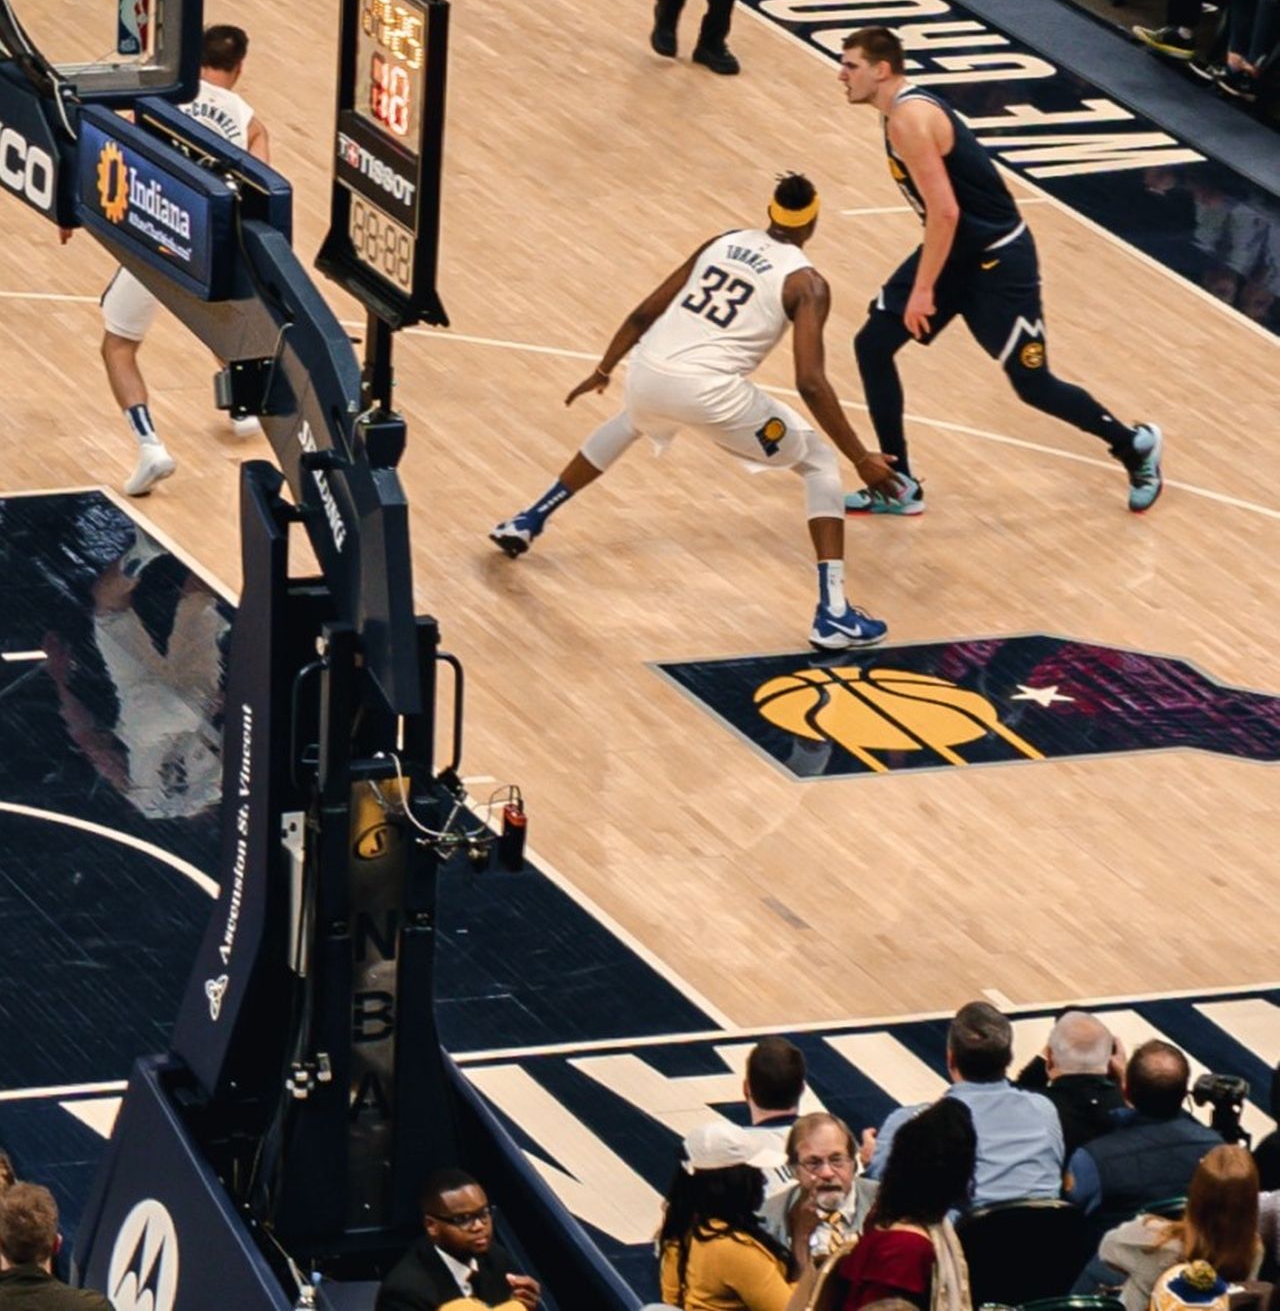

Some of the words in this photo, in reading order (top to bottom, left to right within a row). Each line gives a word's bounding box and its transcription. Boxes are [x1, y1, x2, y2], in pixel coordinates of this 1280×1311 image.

[184, 101, 242, 139] CONNELL
[953, 98, 1208, 180] WE
[129, 167, 191, 240] Indiana
[359, 148, 415, 206] TISSOT
[727, 243, 774, 275] TURNER
[681, 264, 755, 329] 33
[239, 703, 254, 797] Vincent
[237, 804, 250, 837] St.
[219, 840, 247, 966] Ascension
